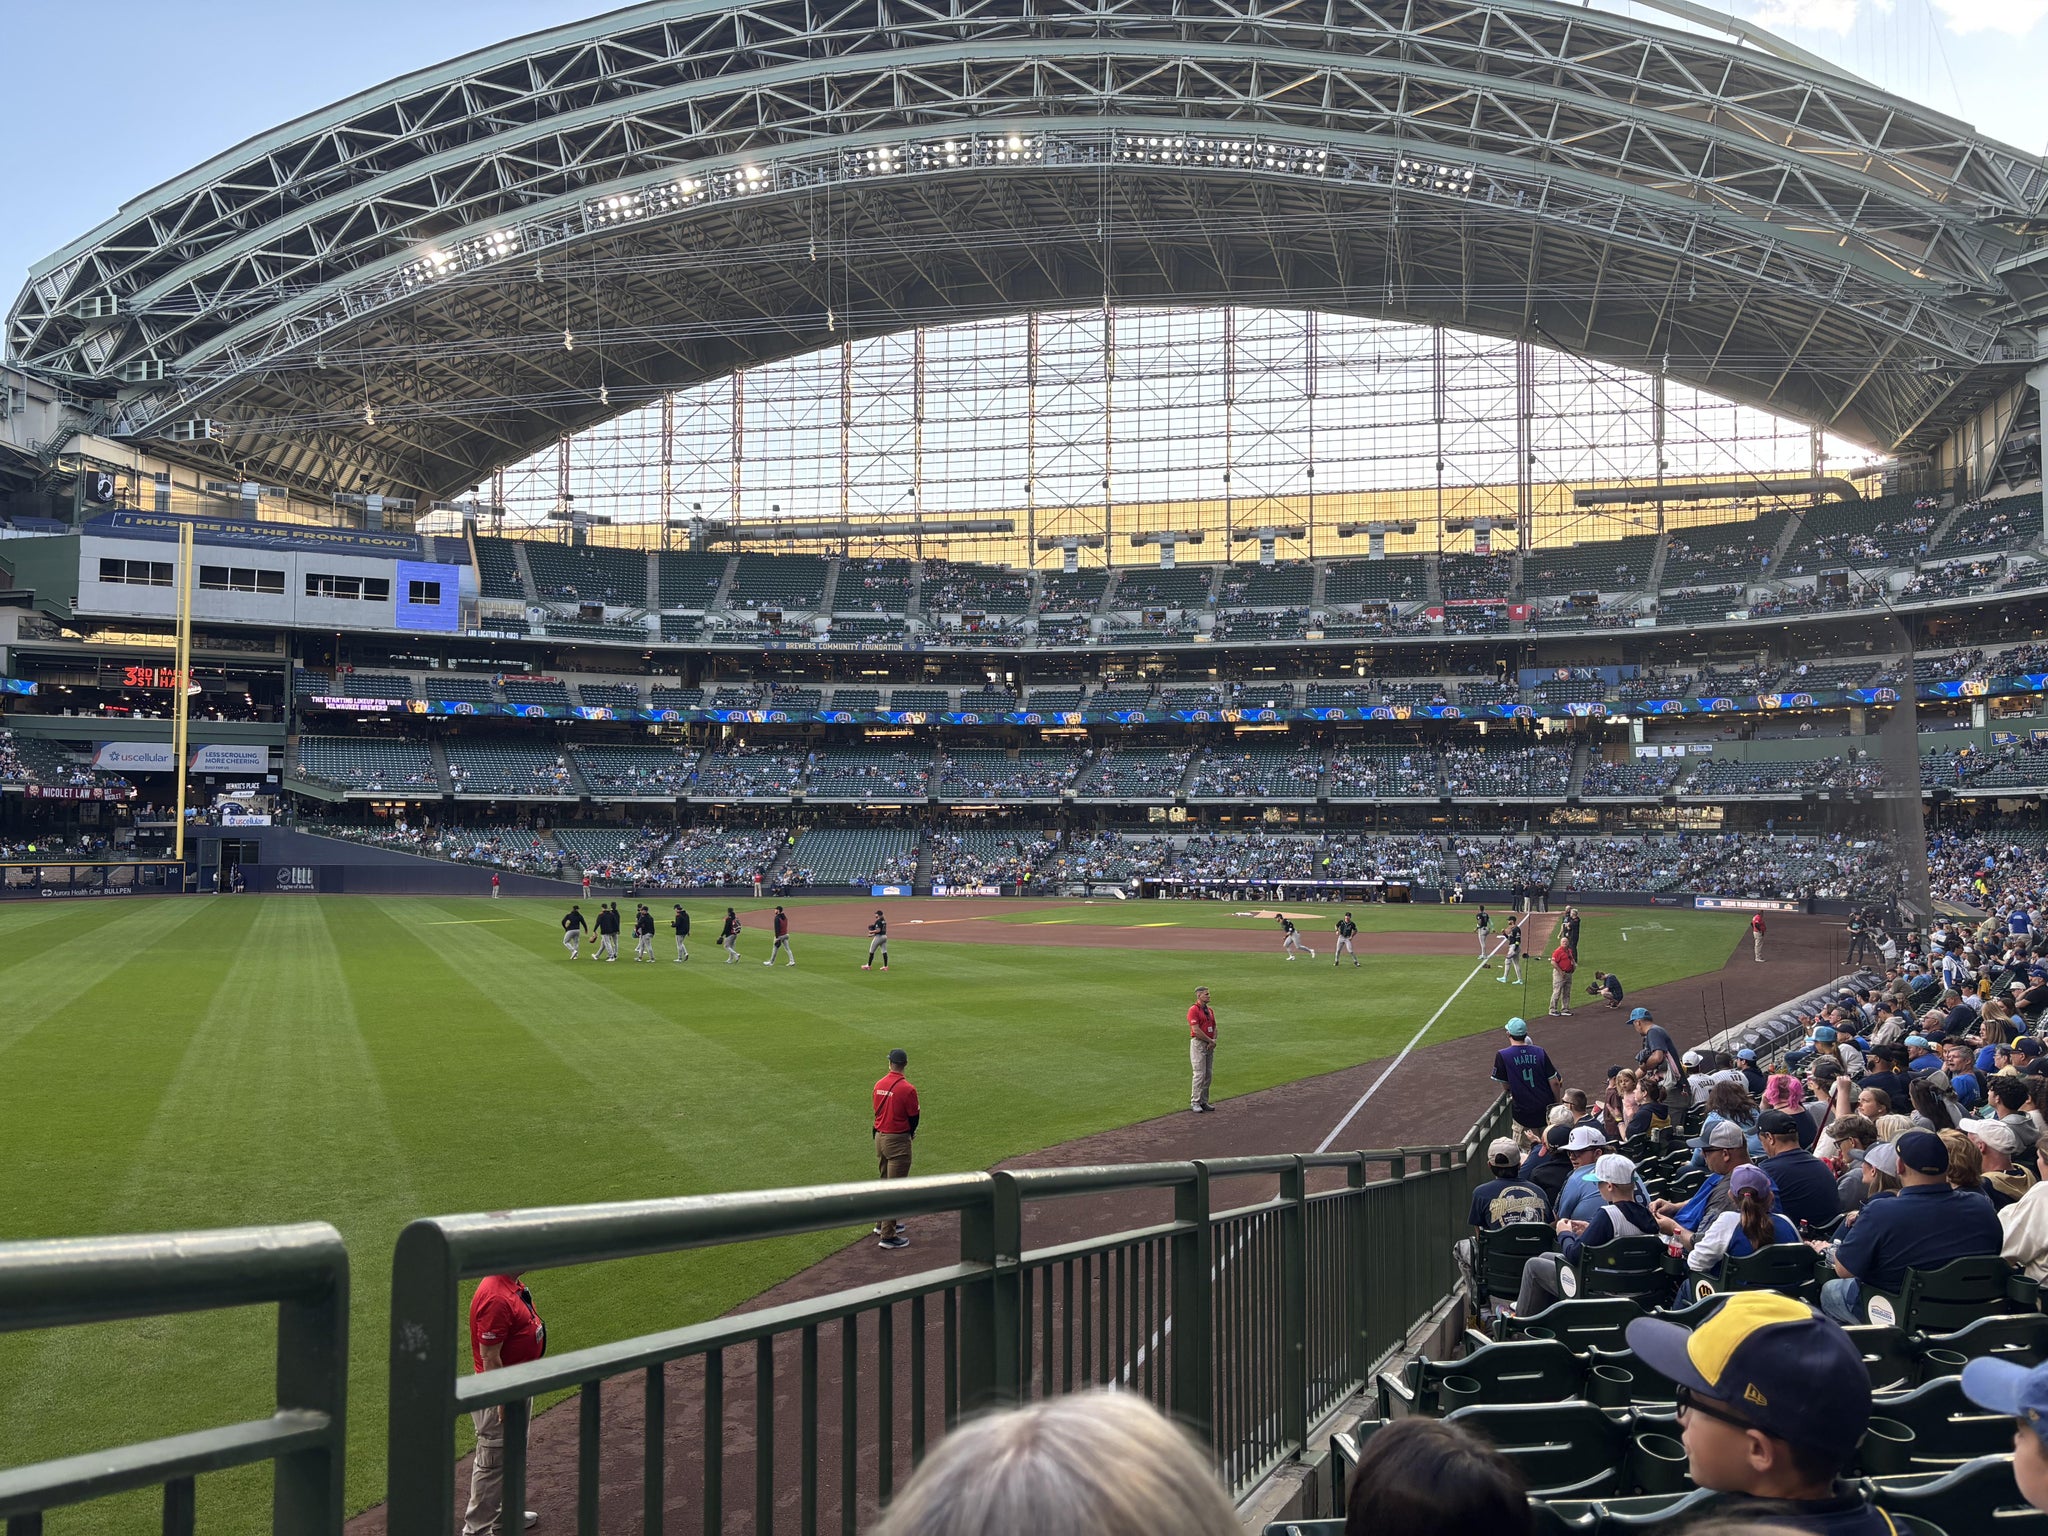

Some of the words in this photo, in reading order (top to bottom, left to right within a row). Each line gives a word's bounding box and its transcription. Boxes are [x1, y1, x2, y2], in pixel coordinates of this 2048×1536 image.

[136, 518, 187, 526] MUS
[225, 525, 246, 533] IN
[250, 527, 288, 537] THE
[293, 531, 354, 543] FRONT
[359, 538, 408, 547] ROW!
[121, 752, 168, 762] uscellular
[42, 788, 72, 798] NICOLET
[75, 789, 90, 798] LAW
[1514, 1055, 1536, 1065] MARTE
[1522, 1068, 1534, 1088] 4
